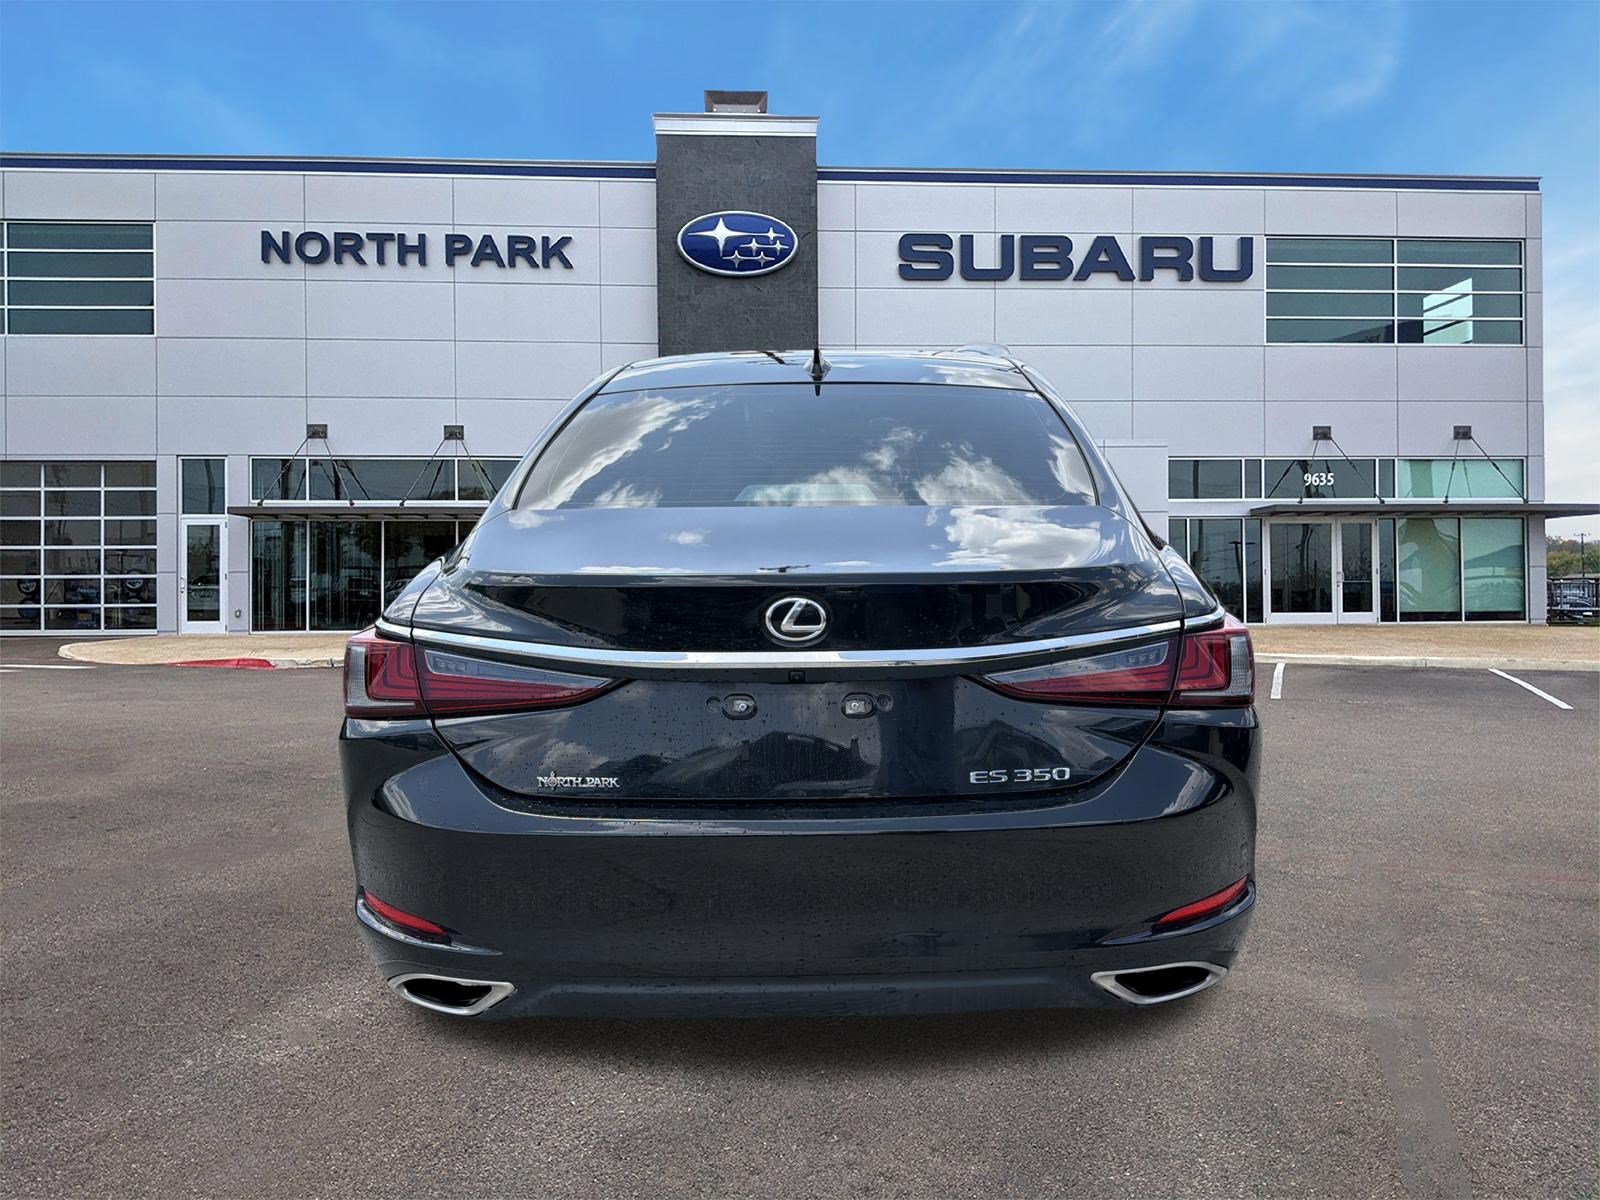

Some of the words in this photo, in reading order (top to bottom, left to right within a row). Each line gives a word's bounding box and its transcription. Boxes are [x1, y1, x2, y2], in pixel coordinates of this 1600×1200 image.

[261, 230, 427, 267] NORTH
[445, 233, 574, 269] PARK
[898, 233, 1254, 282] SUBARU
[1304, 472, 1334, 486] 9635
[583, 777, 620, 788] PARK
[970, 770, 1008, 783] ES
[1014, 767, 1071, 782] 350
